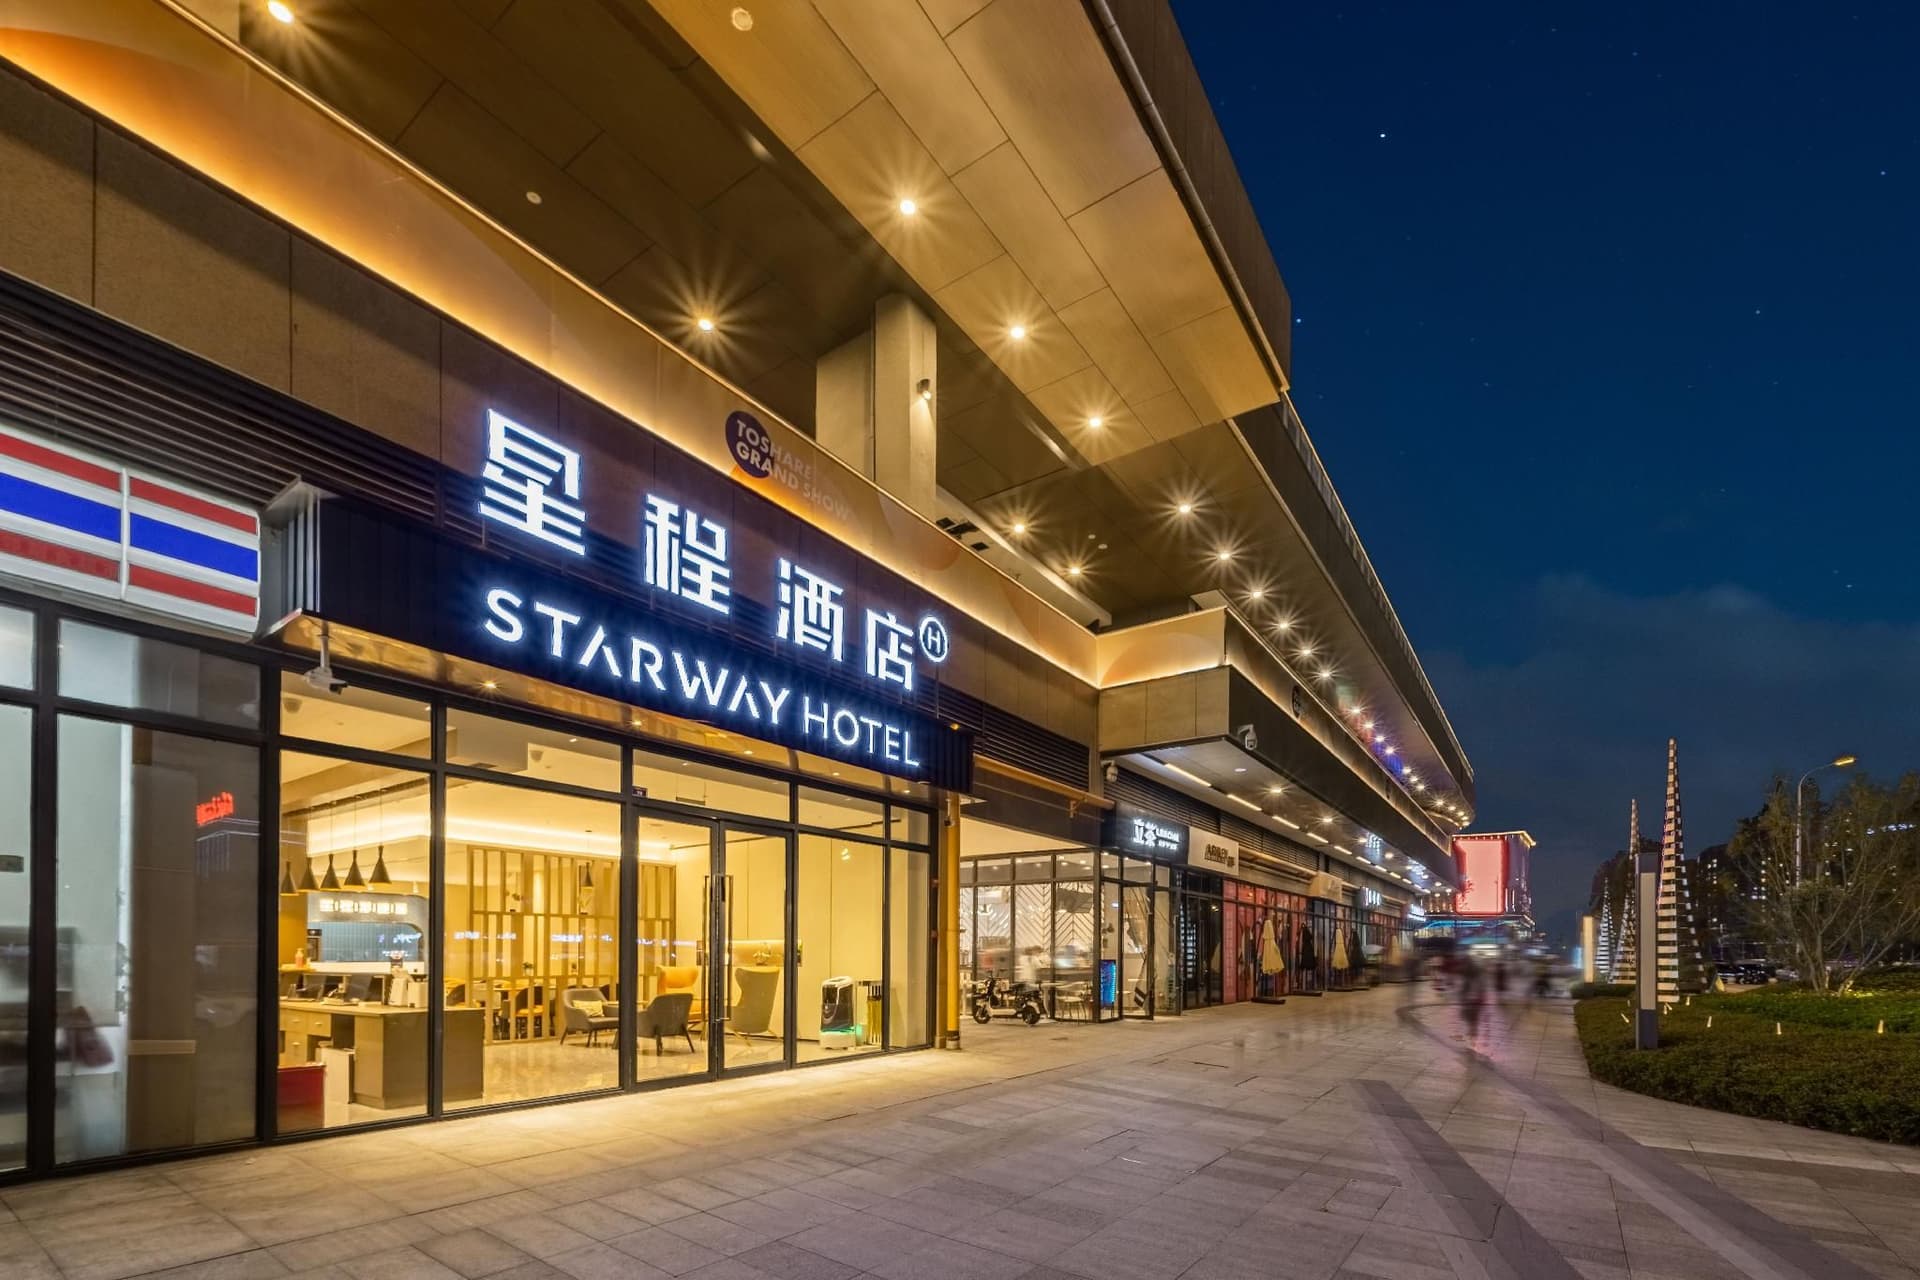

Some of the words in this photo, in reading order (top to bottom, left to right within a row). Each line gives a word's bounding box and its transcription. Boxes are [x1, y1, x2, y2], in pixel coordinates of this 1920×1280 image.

[735, 419, 812, 479] TOSHARE
[735, 441, 798, 491] GRAND
[803, 483, 851, 522] SHOW
[478, 408, 913, 691] 星程酒店
[484, 587, 790, 725] STARWAY
[803, 696, 921, 767] HOTEL
